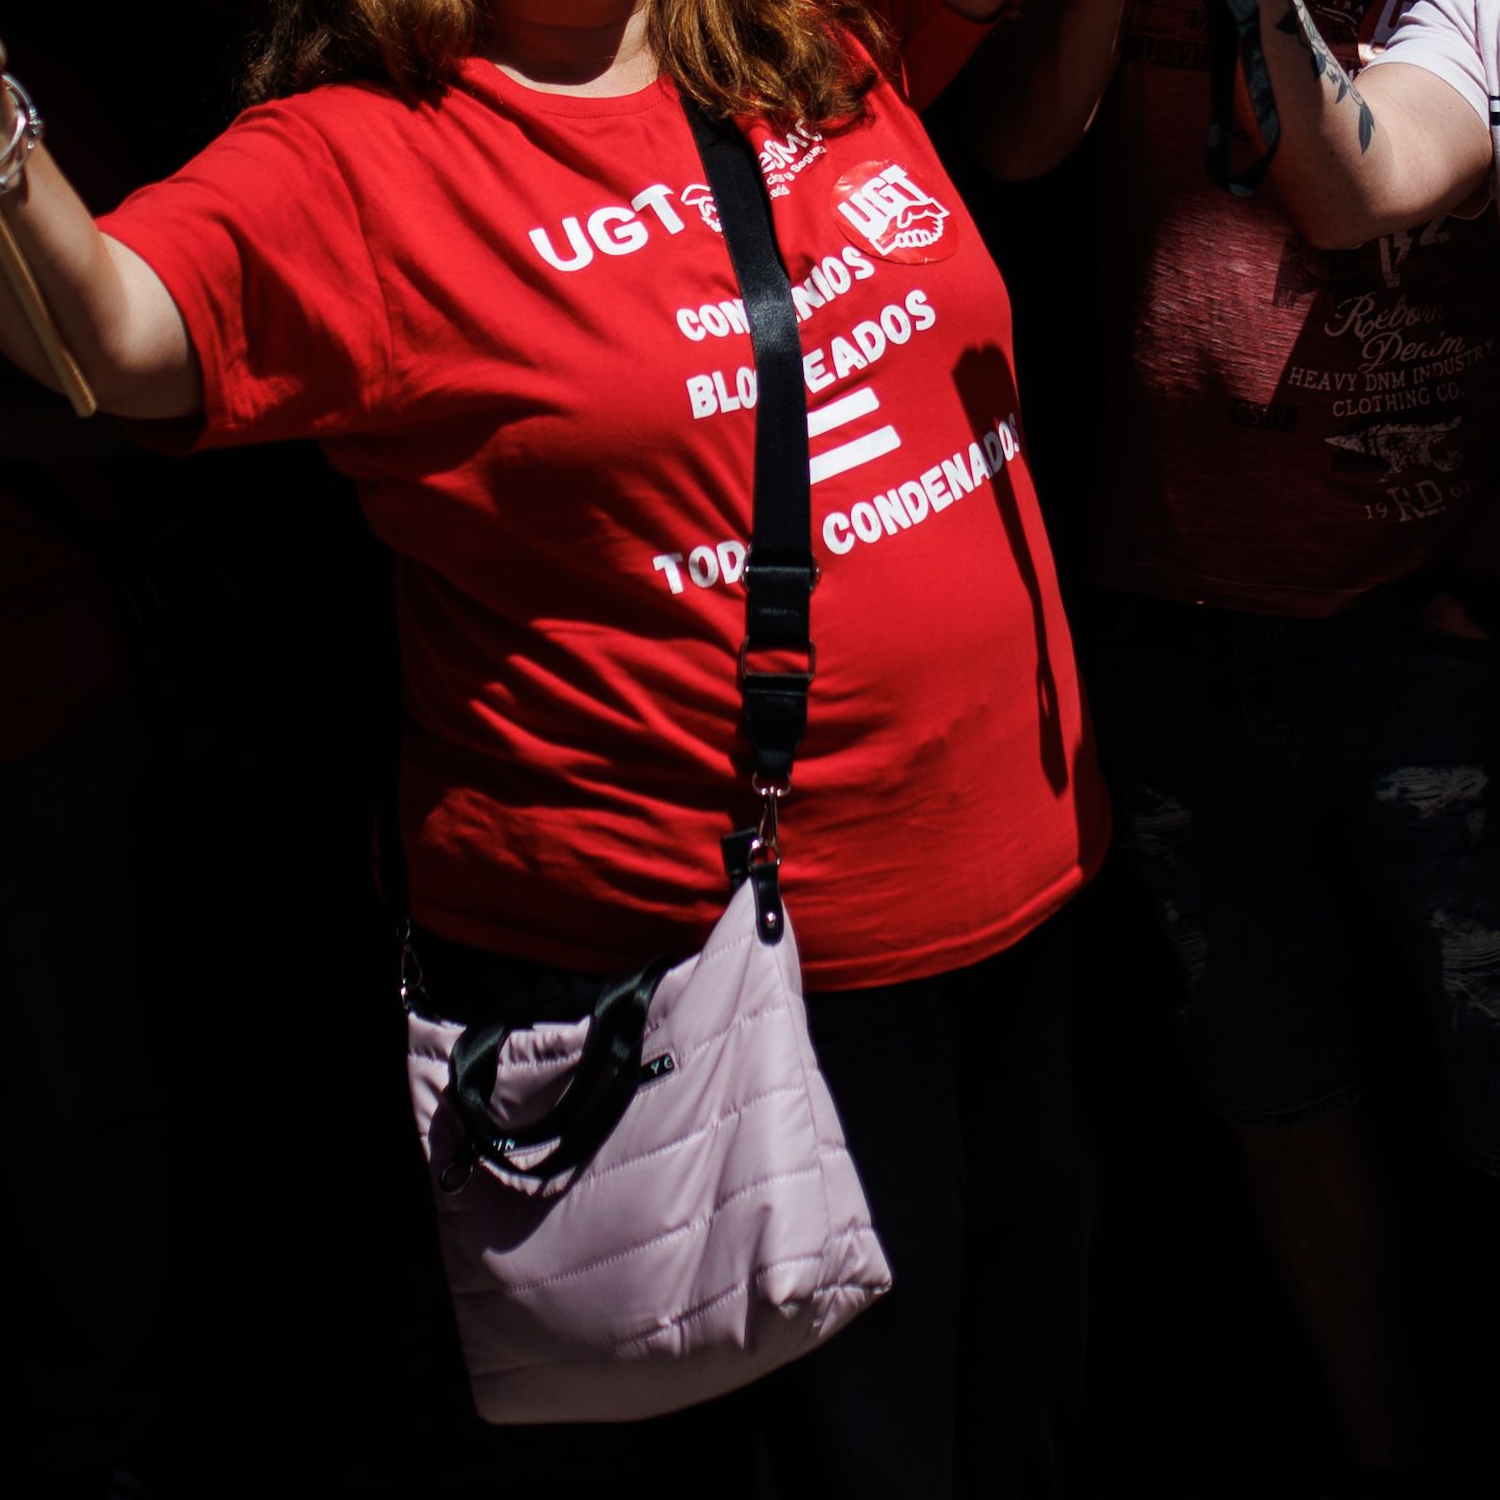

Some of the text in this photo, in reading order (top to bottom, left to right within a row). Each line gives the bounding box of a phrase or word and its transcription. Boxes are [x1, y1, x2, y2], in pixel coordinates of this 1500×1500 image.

[529, 183, 690, 272] UGT
[837, 164, 931, 240] UGT
[676, 246, 875, 341] CONNIOS
[1324, 291, 1447, 344] Reborn
[686, 289, 937, 420] BLOEADOS
[1287, 337, 1495, 393] HEAVY DNM INDUSTRY
[1357, 328, 1466, 374] Denim
[1332, 385, 1431, 418] CLOTHING
[652, 539, 747, 595] TOD
